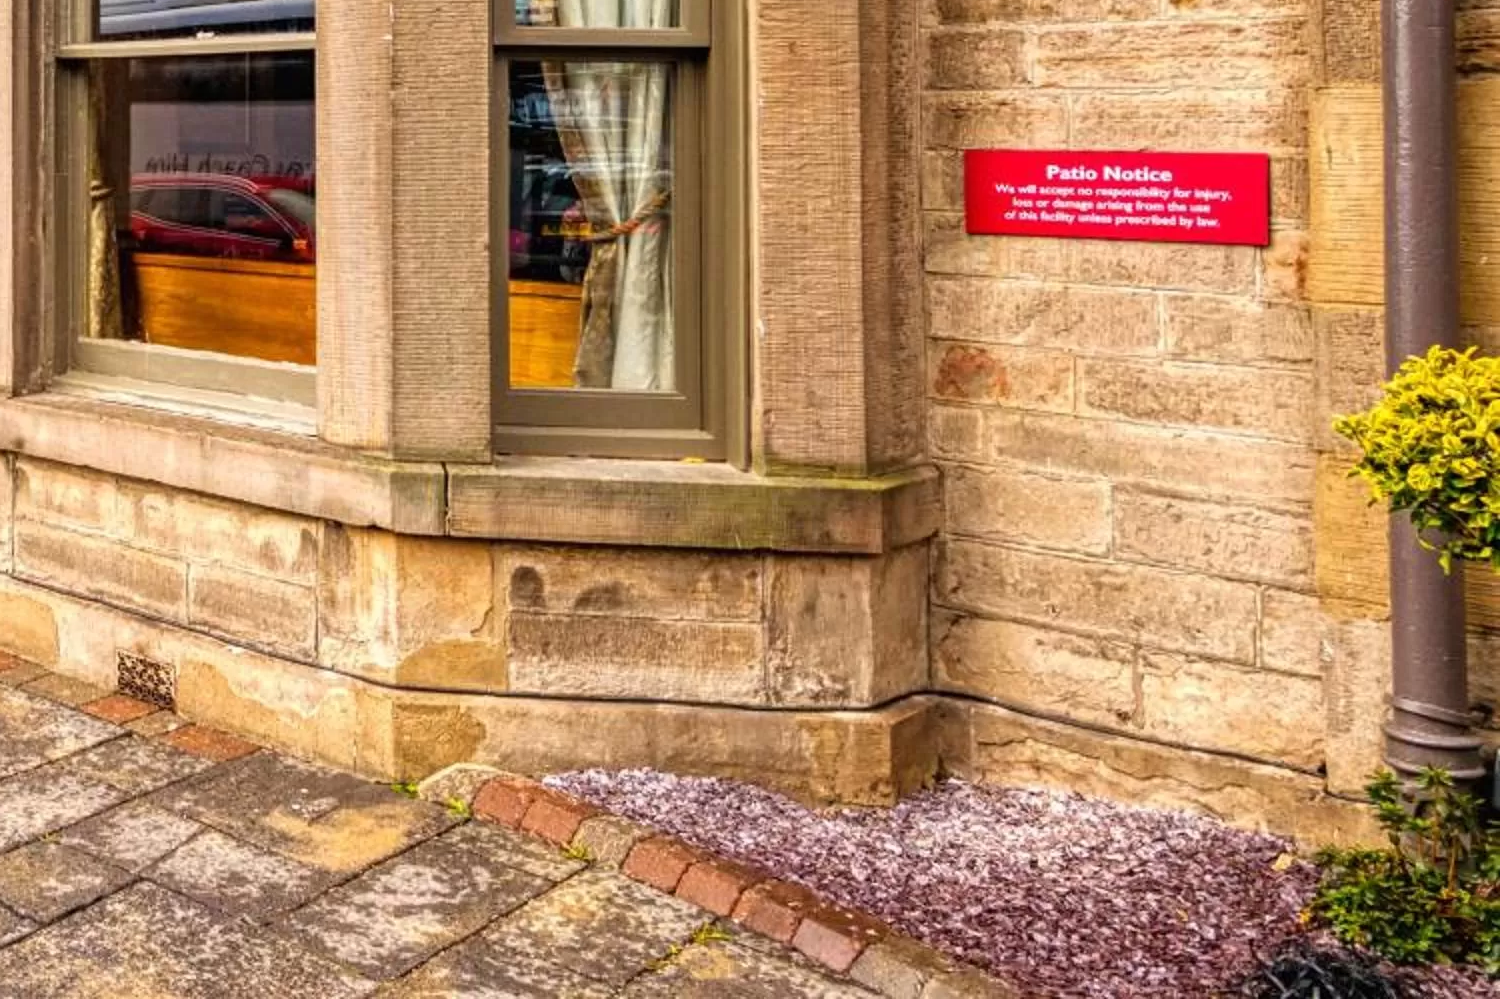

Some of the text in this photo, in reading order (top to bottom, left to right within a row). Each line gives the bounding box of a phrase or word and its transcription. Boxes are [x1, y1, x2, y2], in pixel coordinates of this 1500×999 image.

[1047, 164, 1173, 182] Patio Notice
[995, 183, 1015, 194] We
[1018, 184, 1037, 194] will
[1039, 186, 1075, 198] accept
[1077, 188, 1093, 196] no
[1095, 187, 1171, 200] responsibility
[1173, 187, 1191, 198] for
[1012, 197, 1210, 213] loss or damage arising from the use
[1004, 210, 1016, 220] of
[1018, 210, 1037, 220] this
[1040, 211, 1076, 224] facility
[1078, 213, 1112, 223] unless
[1114, 215, 1177, 227] prescribed
[1179, 215, 1194, 229] by
